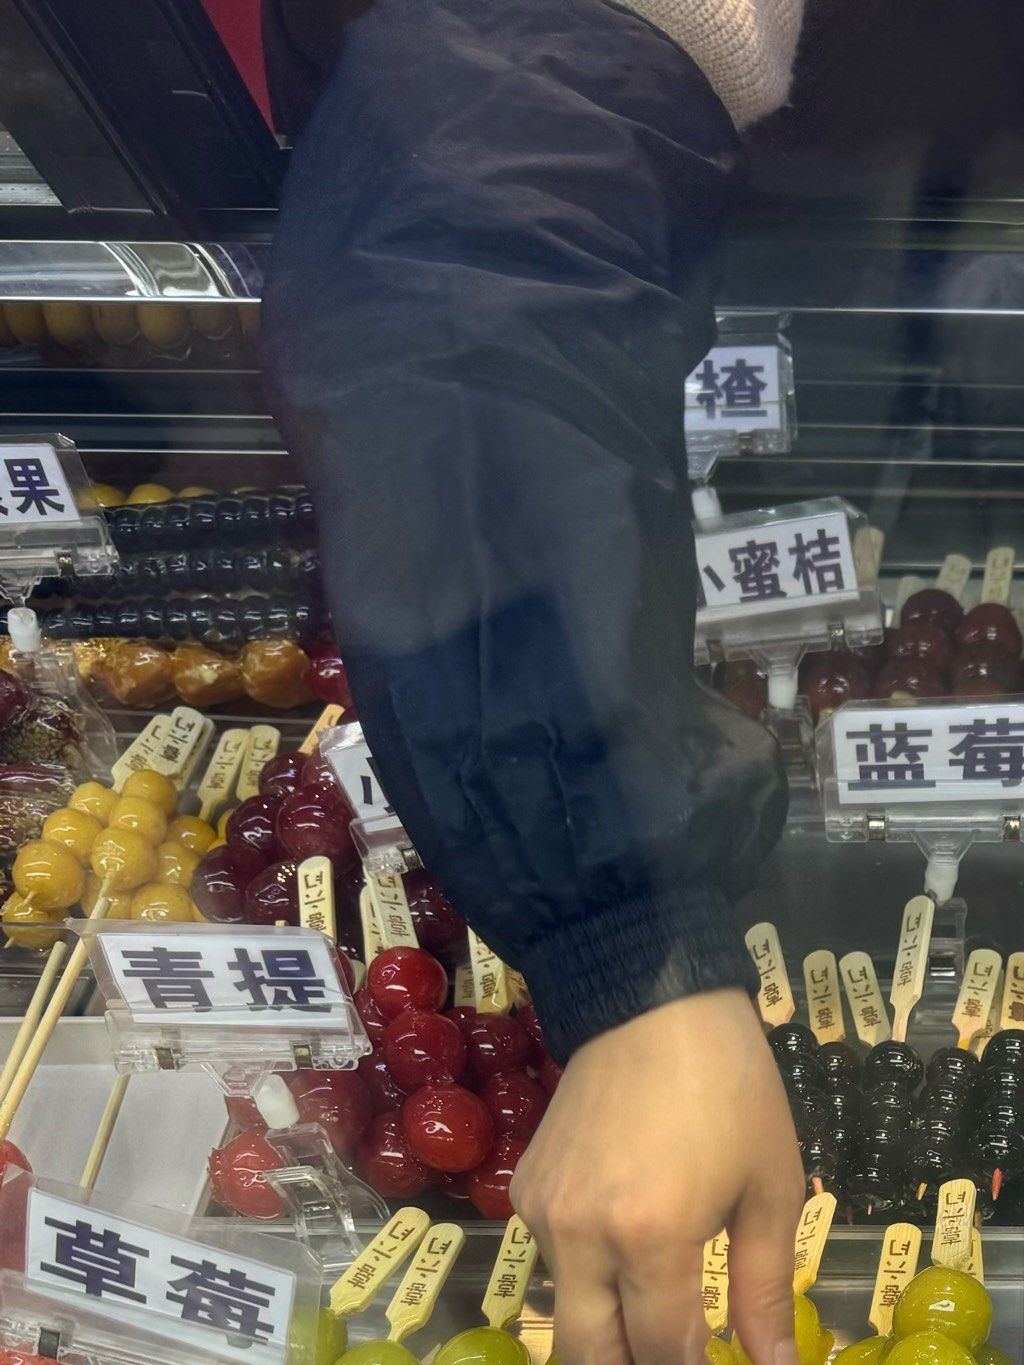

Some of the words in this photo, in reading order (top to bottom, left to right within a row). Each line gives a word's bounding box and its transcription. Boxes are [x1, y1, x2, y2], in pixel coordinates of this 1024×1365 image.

[0, 458, 65, 516] 果
[122, 946, 332, 1014] 青提
[39, 1216, 277, 1349] 草莓
